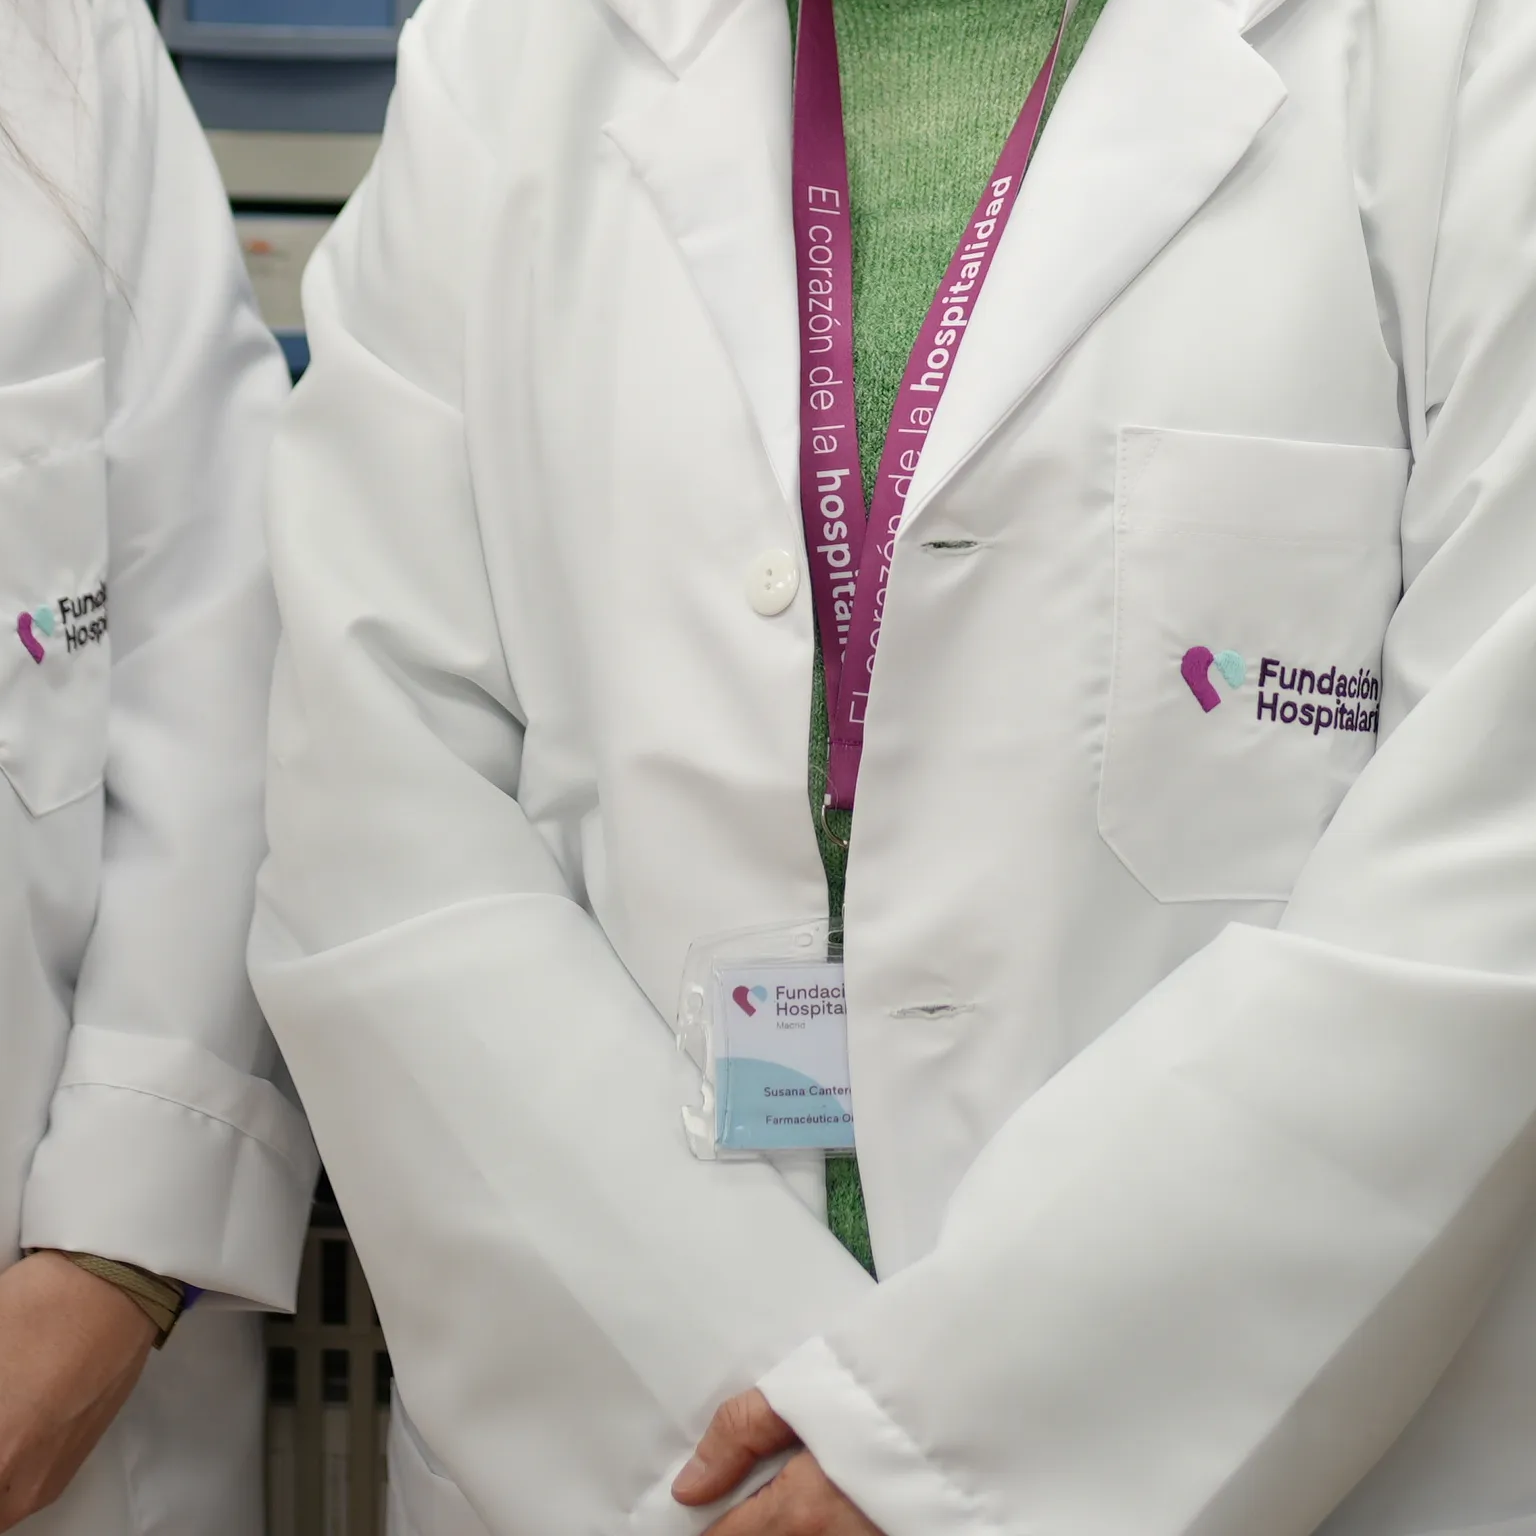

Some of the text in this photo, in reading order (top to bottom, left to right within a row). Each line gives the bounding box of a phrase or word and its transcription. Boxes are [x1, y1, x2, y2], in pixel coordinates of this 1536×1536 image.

[808, 184, 841, 216] El
[808, 224, 842, 354] corazón
[910, 175, 1013, 393] hospitalidad
[809, 366, 843, 411] de
[898, 407, 934, 435] la
[812, 424, 846, 455] la
[1258, 657, 1379, 701] Fundación
[764, 1086, 806, 1098] Susana
[765, 1113, 839, 1126] Farmacéutica
